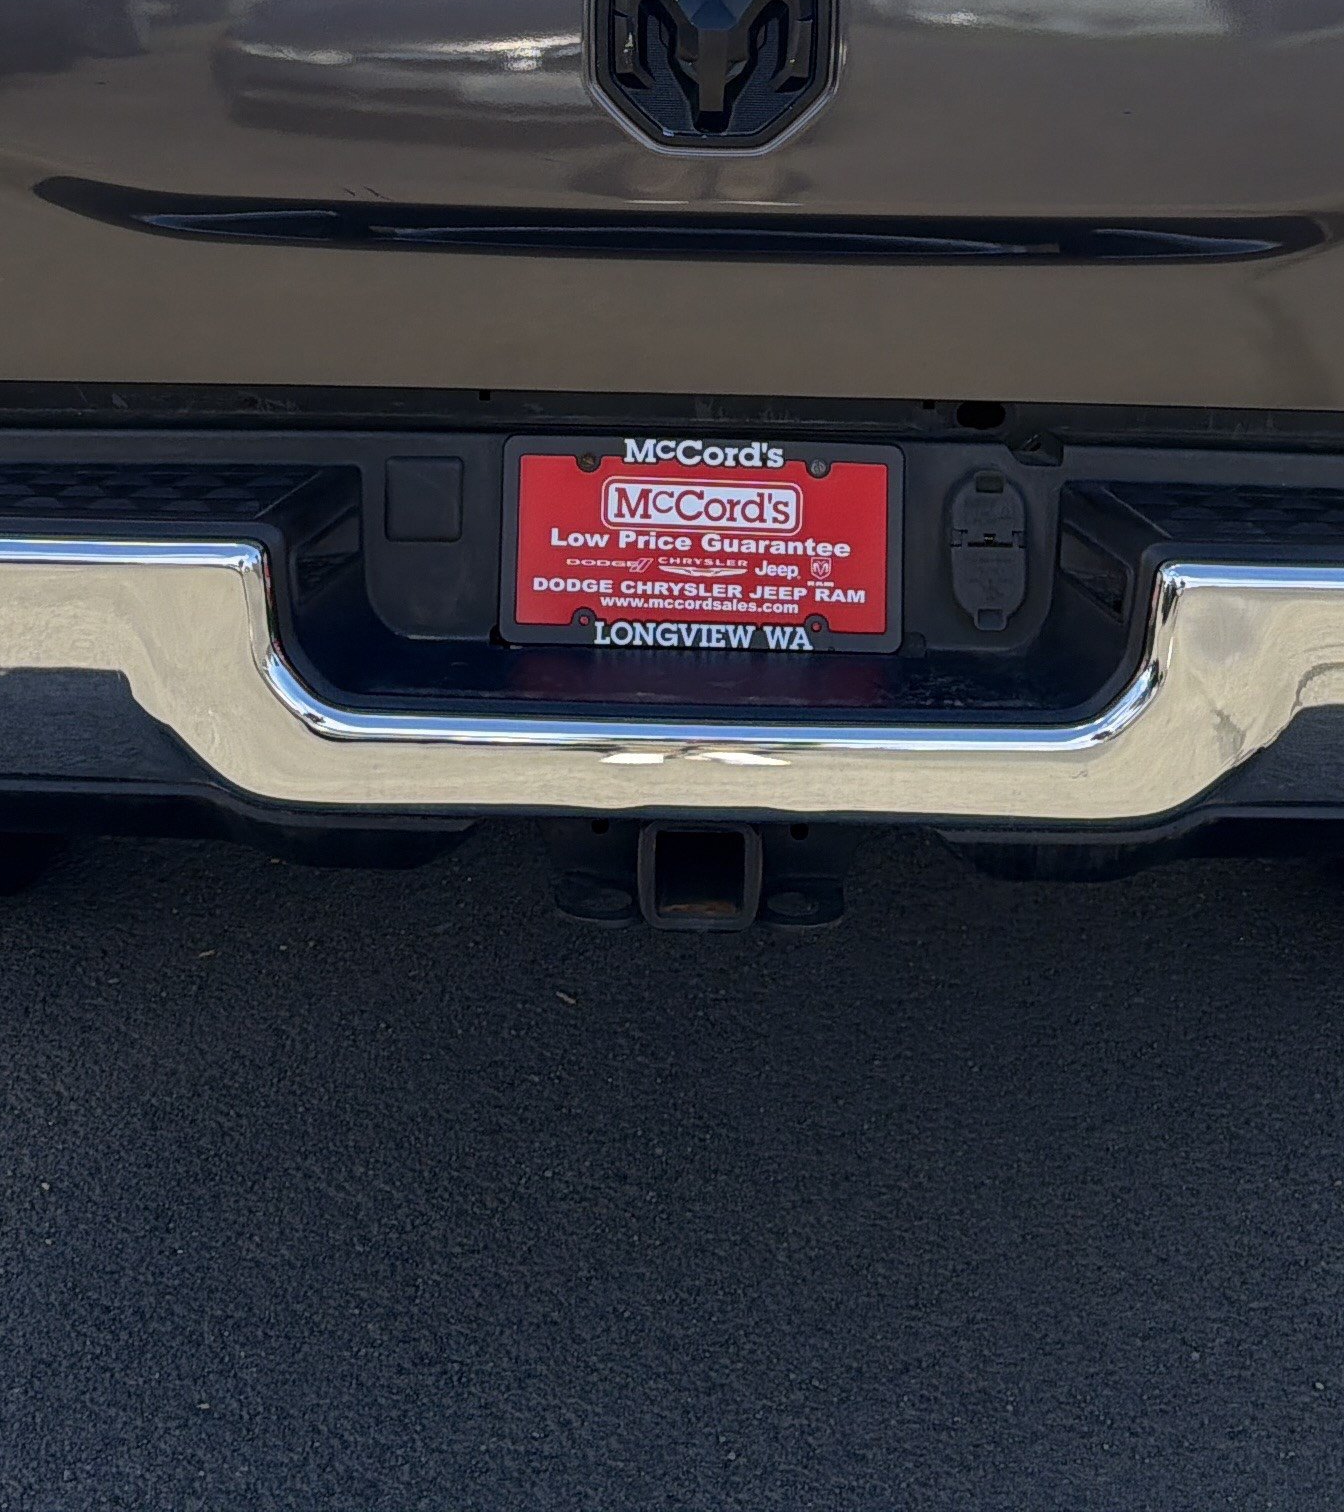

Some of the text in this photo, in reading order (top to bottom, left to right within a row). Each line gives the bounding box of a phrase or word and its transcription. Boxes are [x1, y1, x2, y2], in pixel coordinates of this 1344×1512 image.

[623, 438, 785, 468] McCord's
[613, 486, 790, 526] McCord's
[550, 527, 852, 557] Low Price Guarantee
[566, 557, 638, 569] DODGE
[657, 556, 749, 568] CHRYSLER
[754, 560, 799, 580] Jeep
[532, 576, 866, 604] DODGE CHRYSLER JEEP RAM
[599, 596, 799, 615] www.mccordsales.com
[594, 620, 814, 651] LONGVIEW WA
